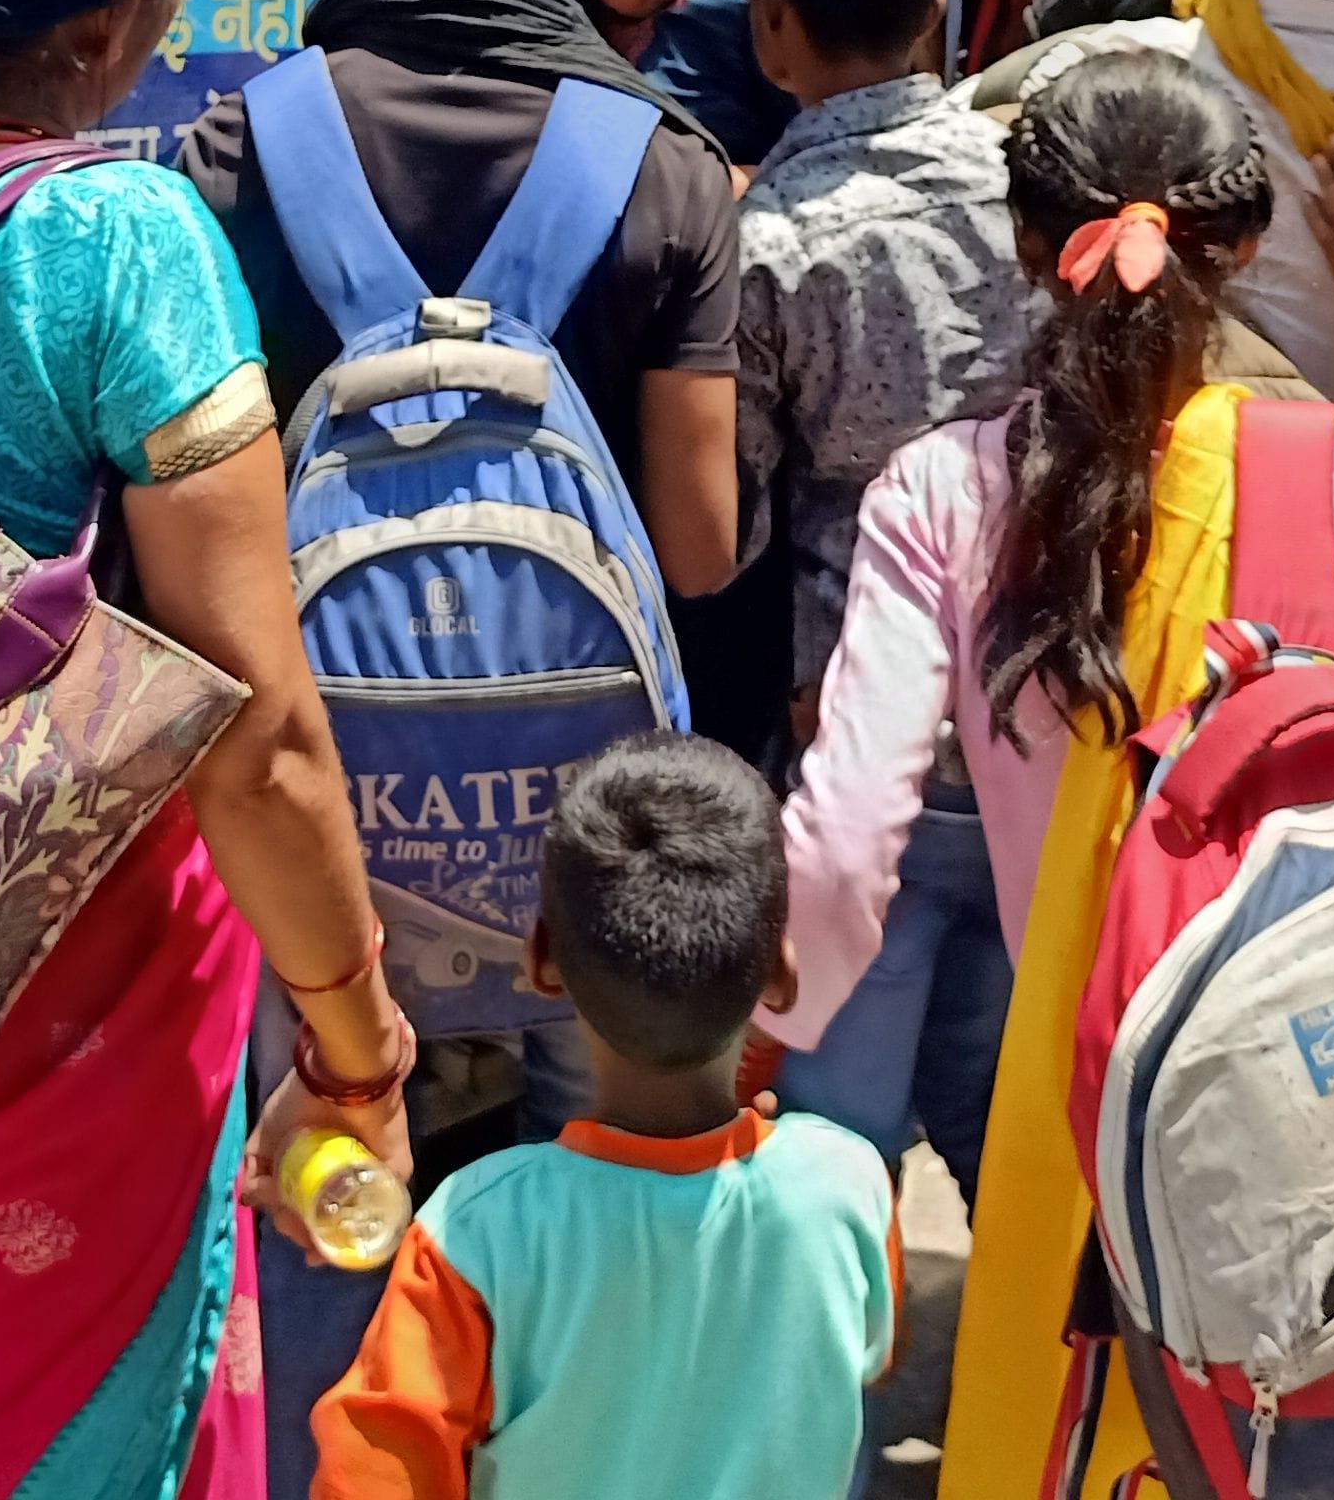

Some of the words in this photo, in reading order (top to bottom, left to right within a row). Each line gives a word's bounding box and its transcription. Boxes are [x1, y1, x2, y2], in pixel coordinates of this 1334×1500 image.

[347, 760, 585, 832] KATE
[455, 839, 487, 863] to
[499, 870, 541, 899] TIM
